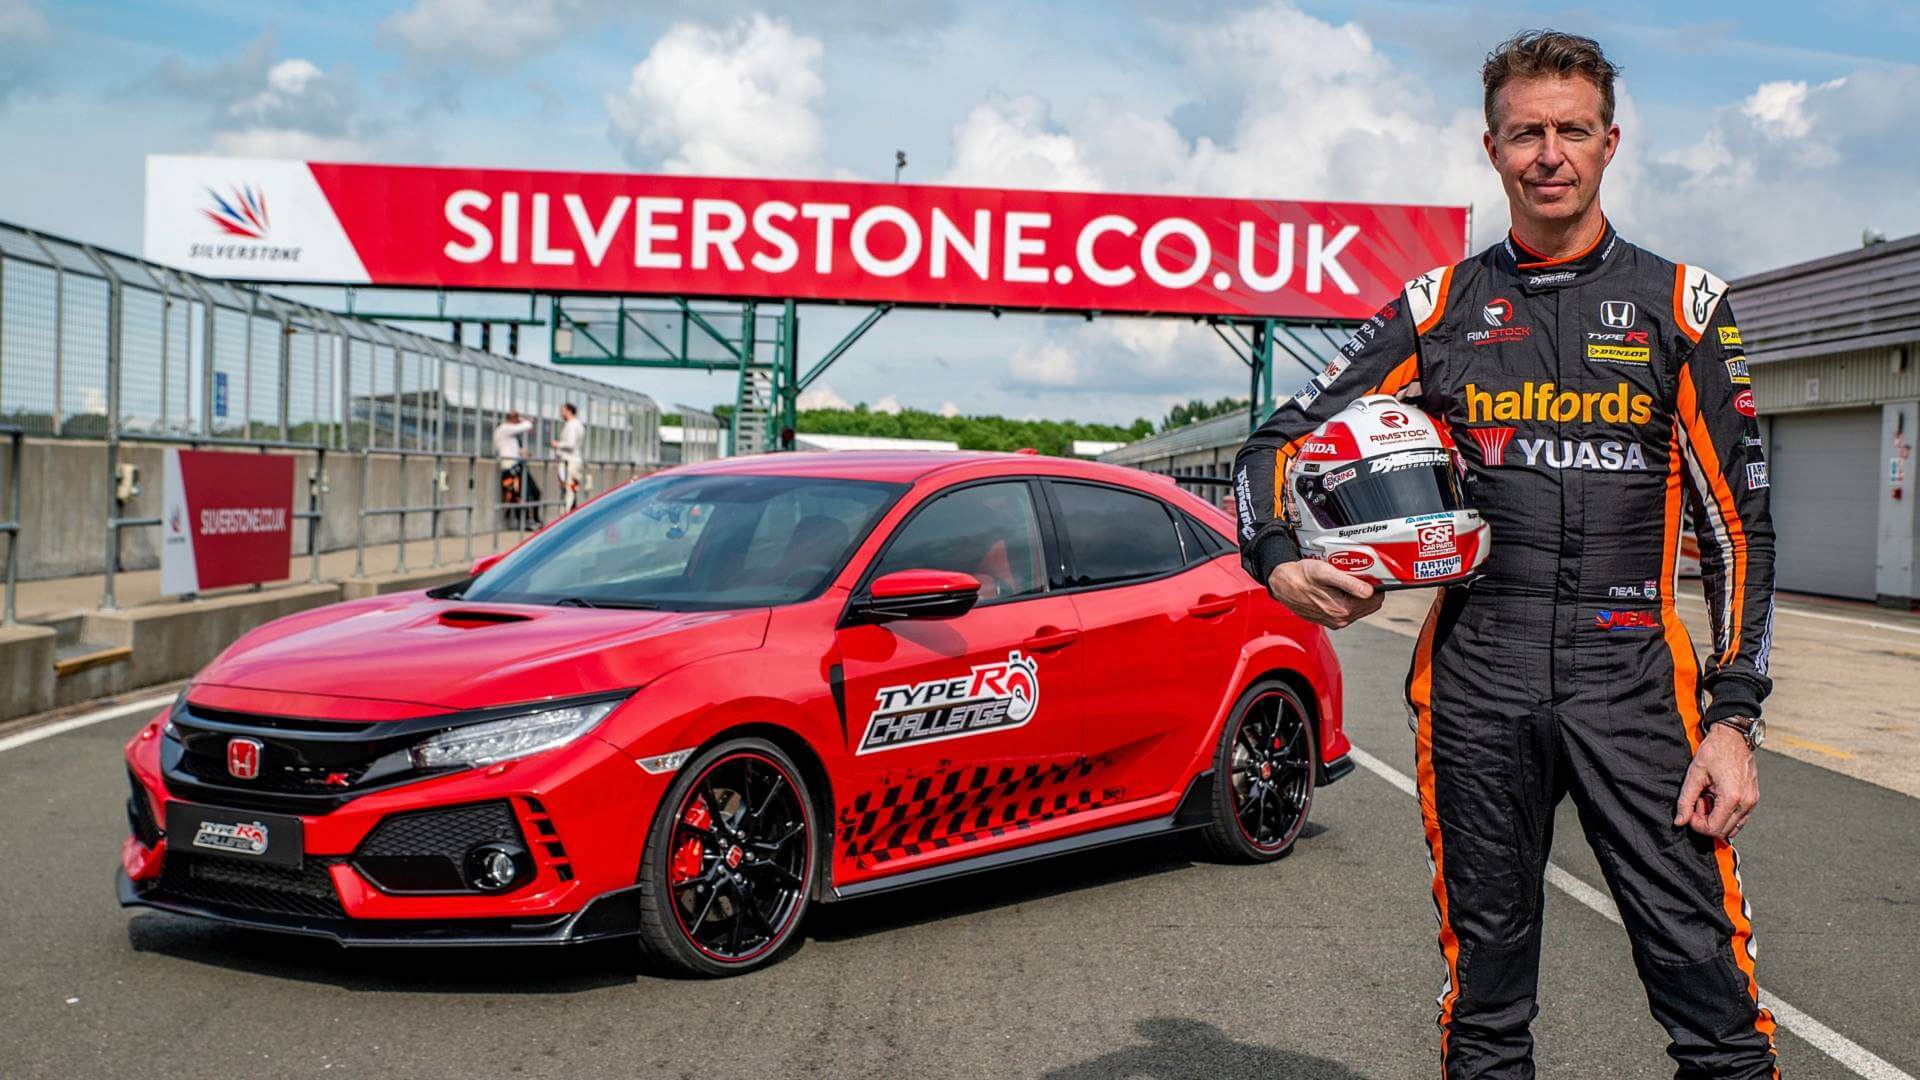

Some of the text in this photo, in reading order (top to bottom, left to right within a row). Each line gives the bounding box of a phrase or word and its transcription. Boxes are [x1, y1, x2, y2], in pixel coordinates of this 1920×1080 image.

[444, 190, 1360, 295] SILVERSTONE.CO.UK
[189, 242, 303, 261] SILVERSTONE
[1467, 327, 1530, 341] RIMSTOCK
[1587, 332, 1625, 341] TYPE
[1600, 349, 1647, 357] DUNLOP
[1465, 382, 1653, 425] halfords
[1370, 429, 1430, 442] RIMSTOCK
[1517, 438, 1648, 471] YUASA
[1338, 524, 1388, 537] Superchips
[1421, 525, 1453, 544] GSF
[1331, 557, 1368, 565] DELPHI
[1421, 556, 1460, 570] ARTHUR
[1420, 566, 1453, 578] McKAY
[1609, 586, 1641, 597] NEAL
[880, 666, 1008, 711] TYPE R
[867, 699, 1011, 745] CHALLENGE
